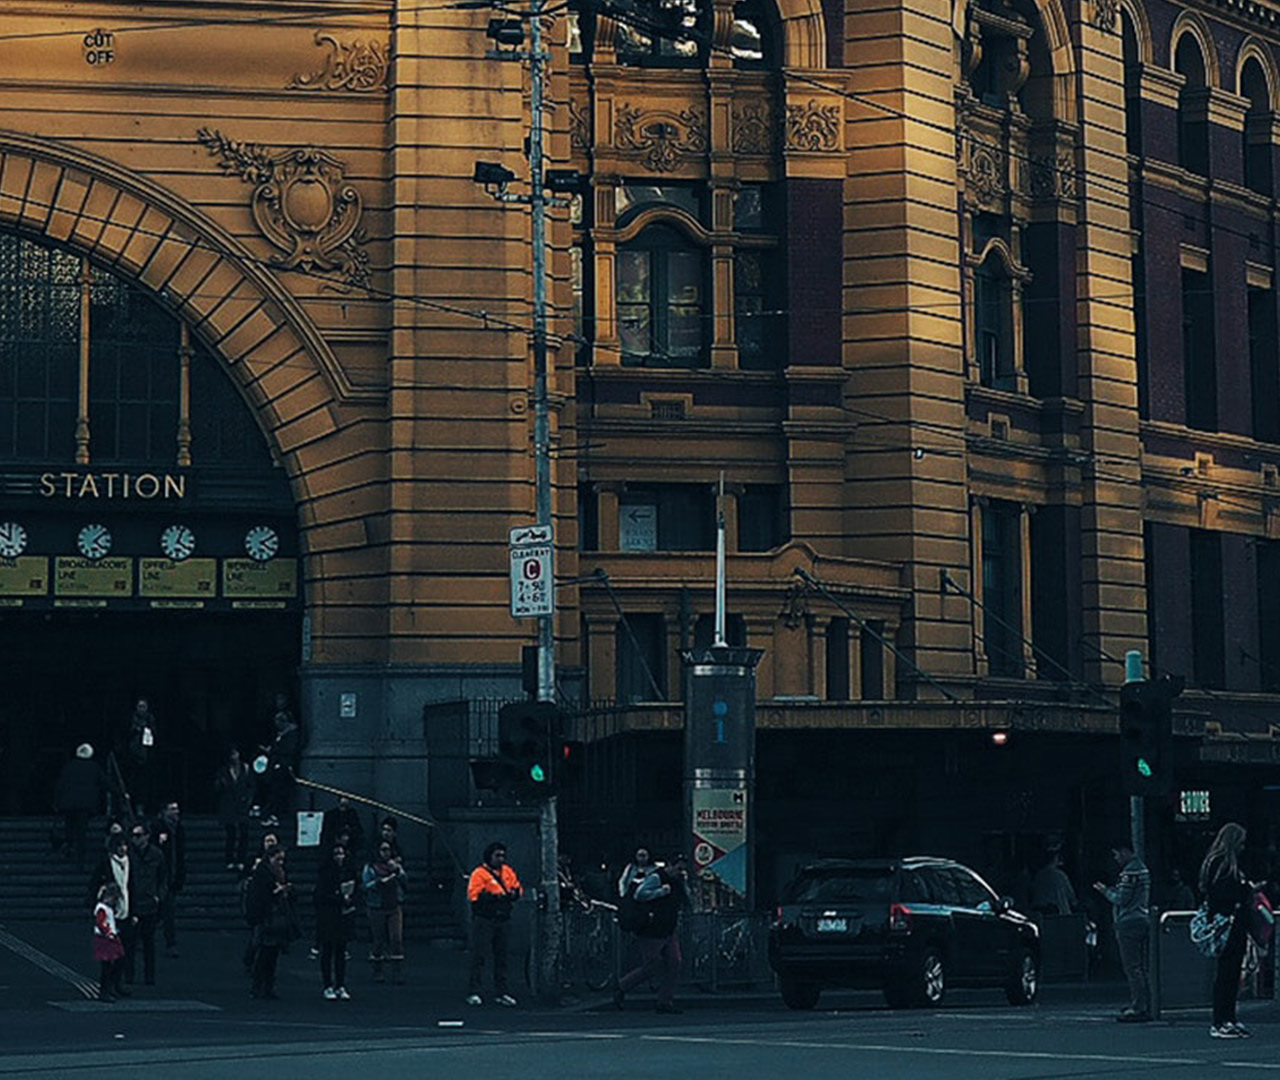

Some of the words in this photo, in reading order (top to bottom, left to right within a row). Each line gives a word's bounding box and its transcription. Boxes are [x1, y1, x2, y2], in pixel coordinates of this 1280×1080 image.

[84, 34, 113, 47] CUT
[86, 50, 114, 64] OFF
[39, 472, 186, 499] STATION
